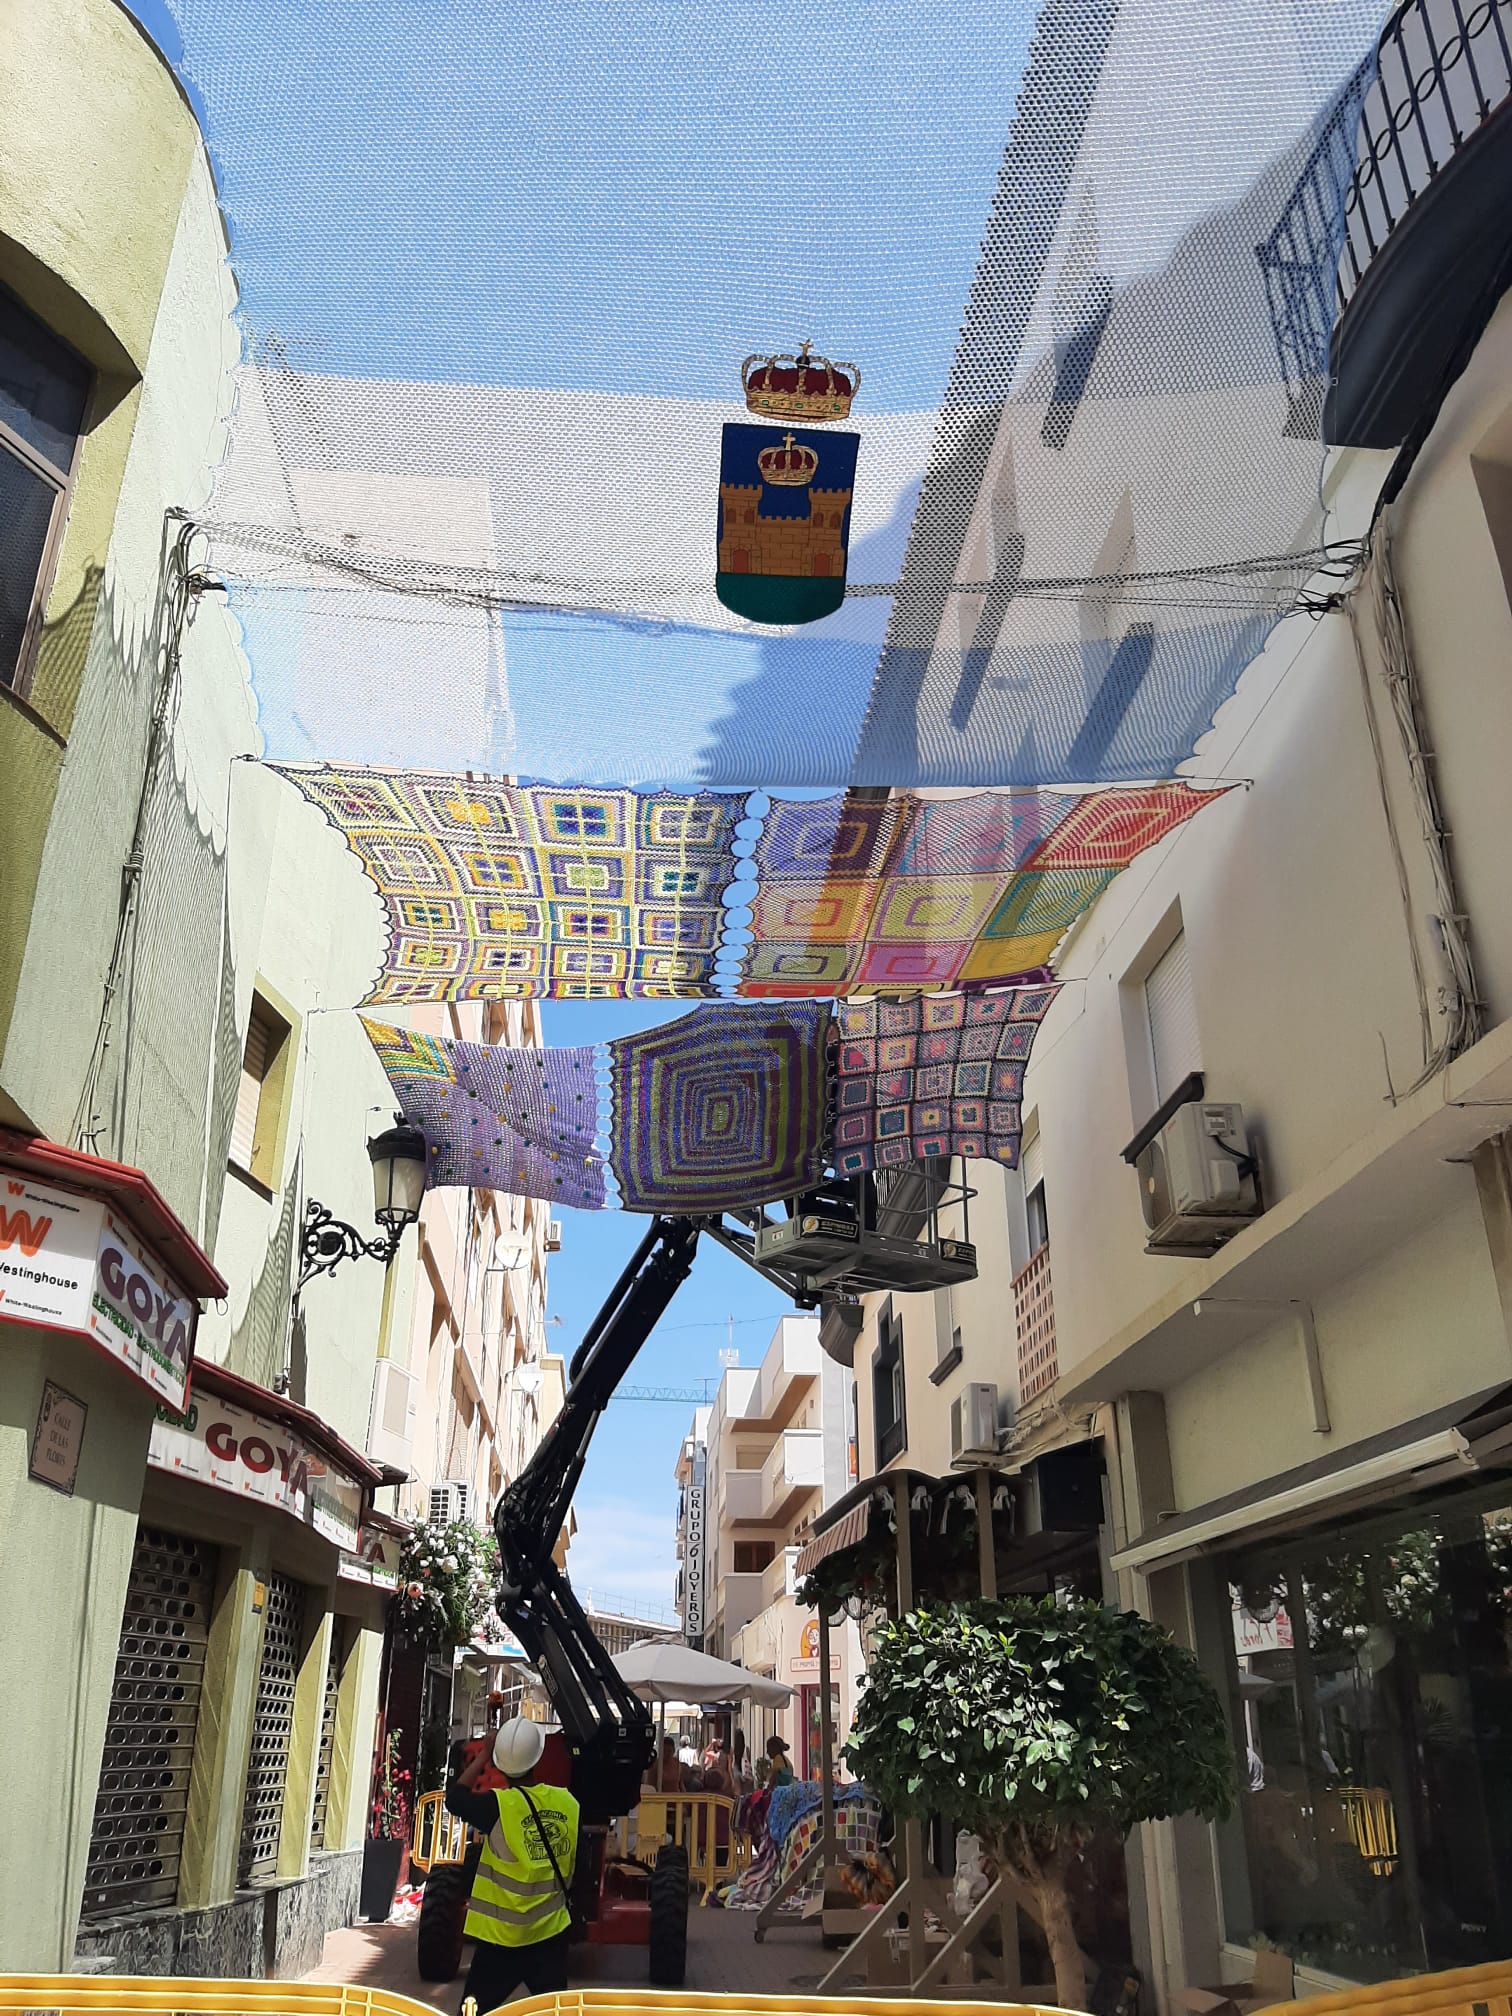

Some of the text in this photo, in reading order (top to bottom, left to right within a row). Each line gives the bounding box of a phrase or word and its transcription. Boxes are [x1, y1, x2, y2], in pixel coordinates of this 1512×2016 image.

[101, 1248, 188, 1365] GOYA
[205, 1422, 308, 1499] GOYA
[689, 1488, 701, 1542] GRUPO
[688, 1559, 700, 1633] JOYEROS
